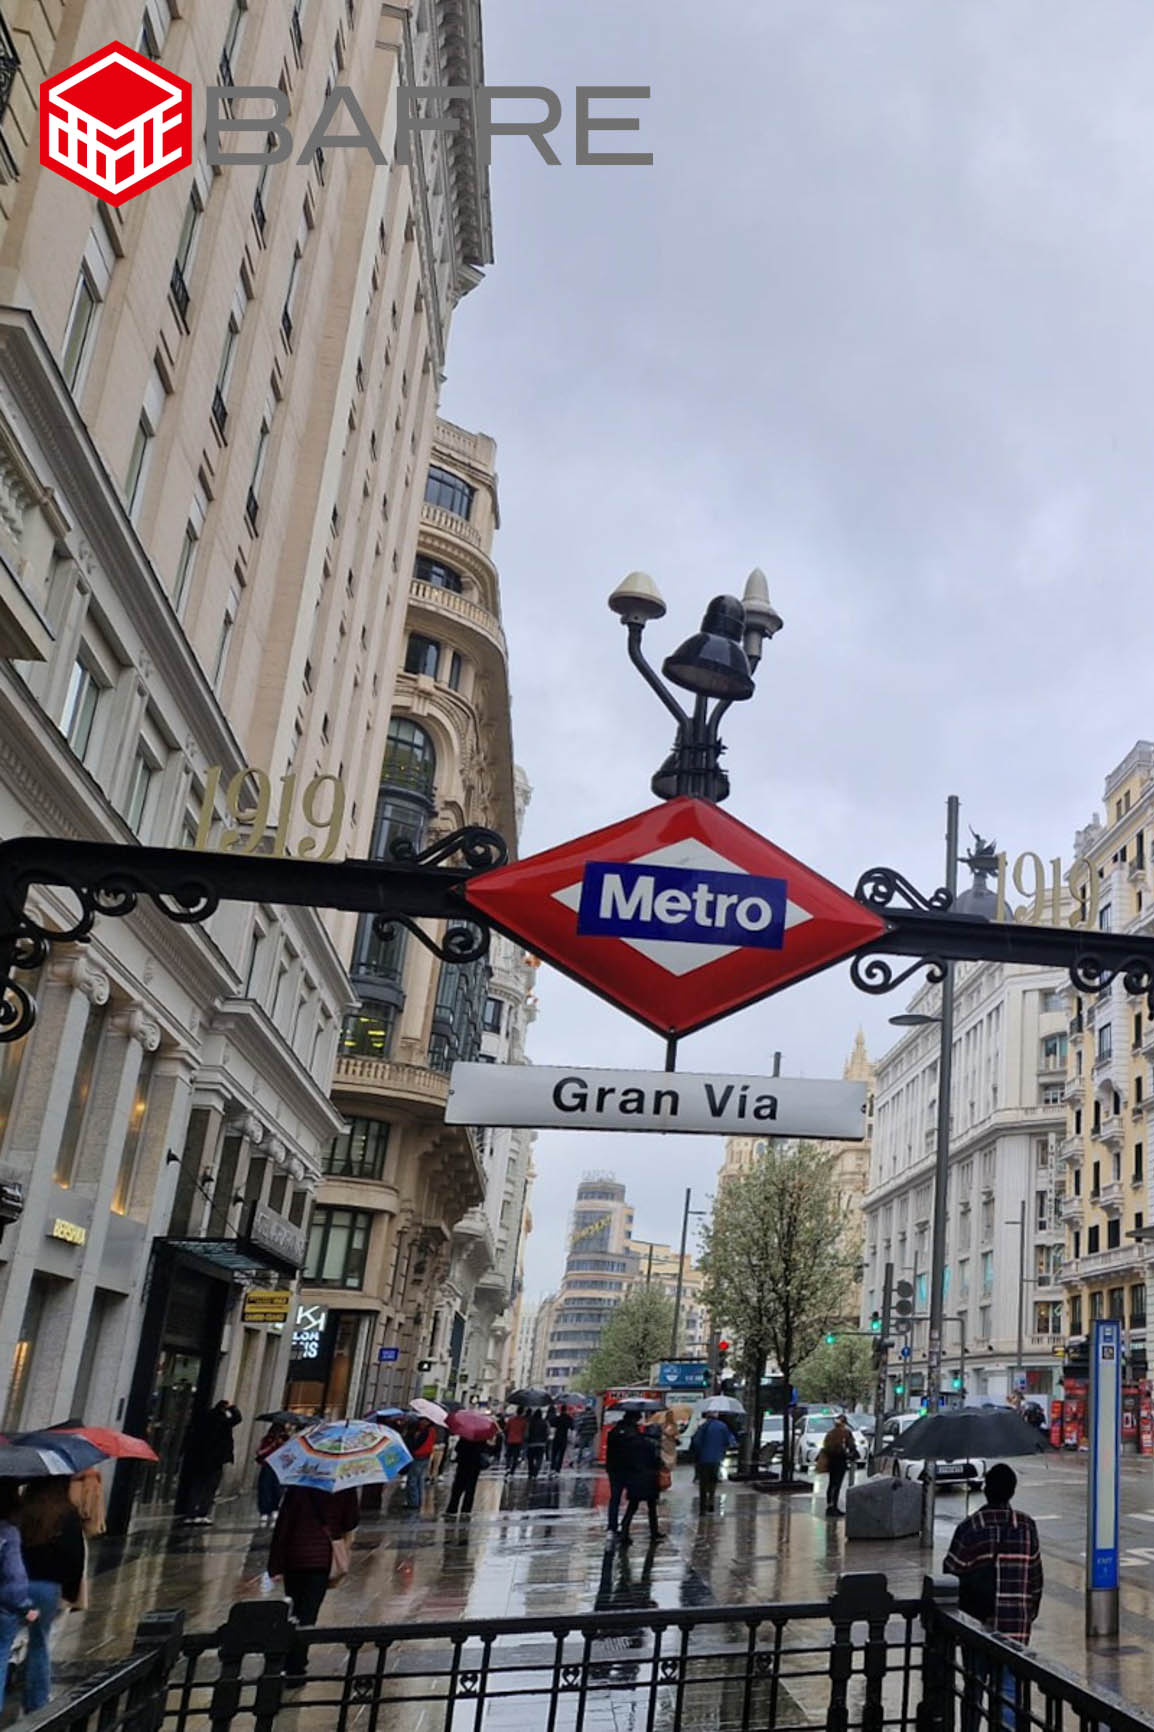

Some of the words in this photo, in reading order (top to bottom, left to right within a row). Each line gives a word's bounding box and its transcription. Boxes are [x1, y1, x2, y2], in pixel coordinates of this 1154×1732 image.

[195, 766, 346, 860] 1919
[598, 873, 773, 932] Metro
[996, 851, 1099, 930] 1919
[552, 1076, 680, 1116] Gran
[704, 1083, 779, 1122] Vía
